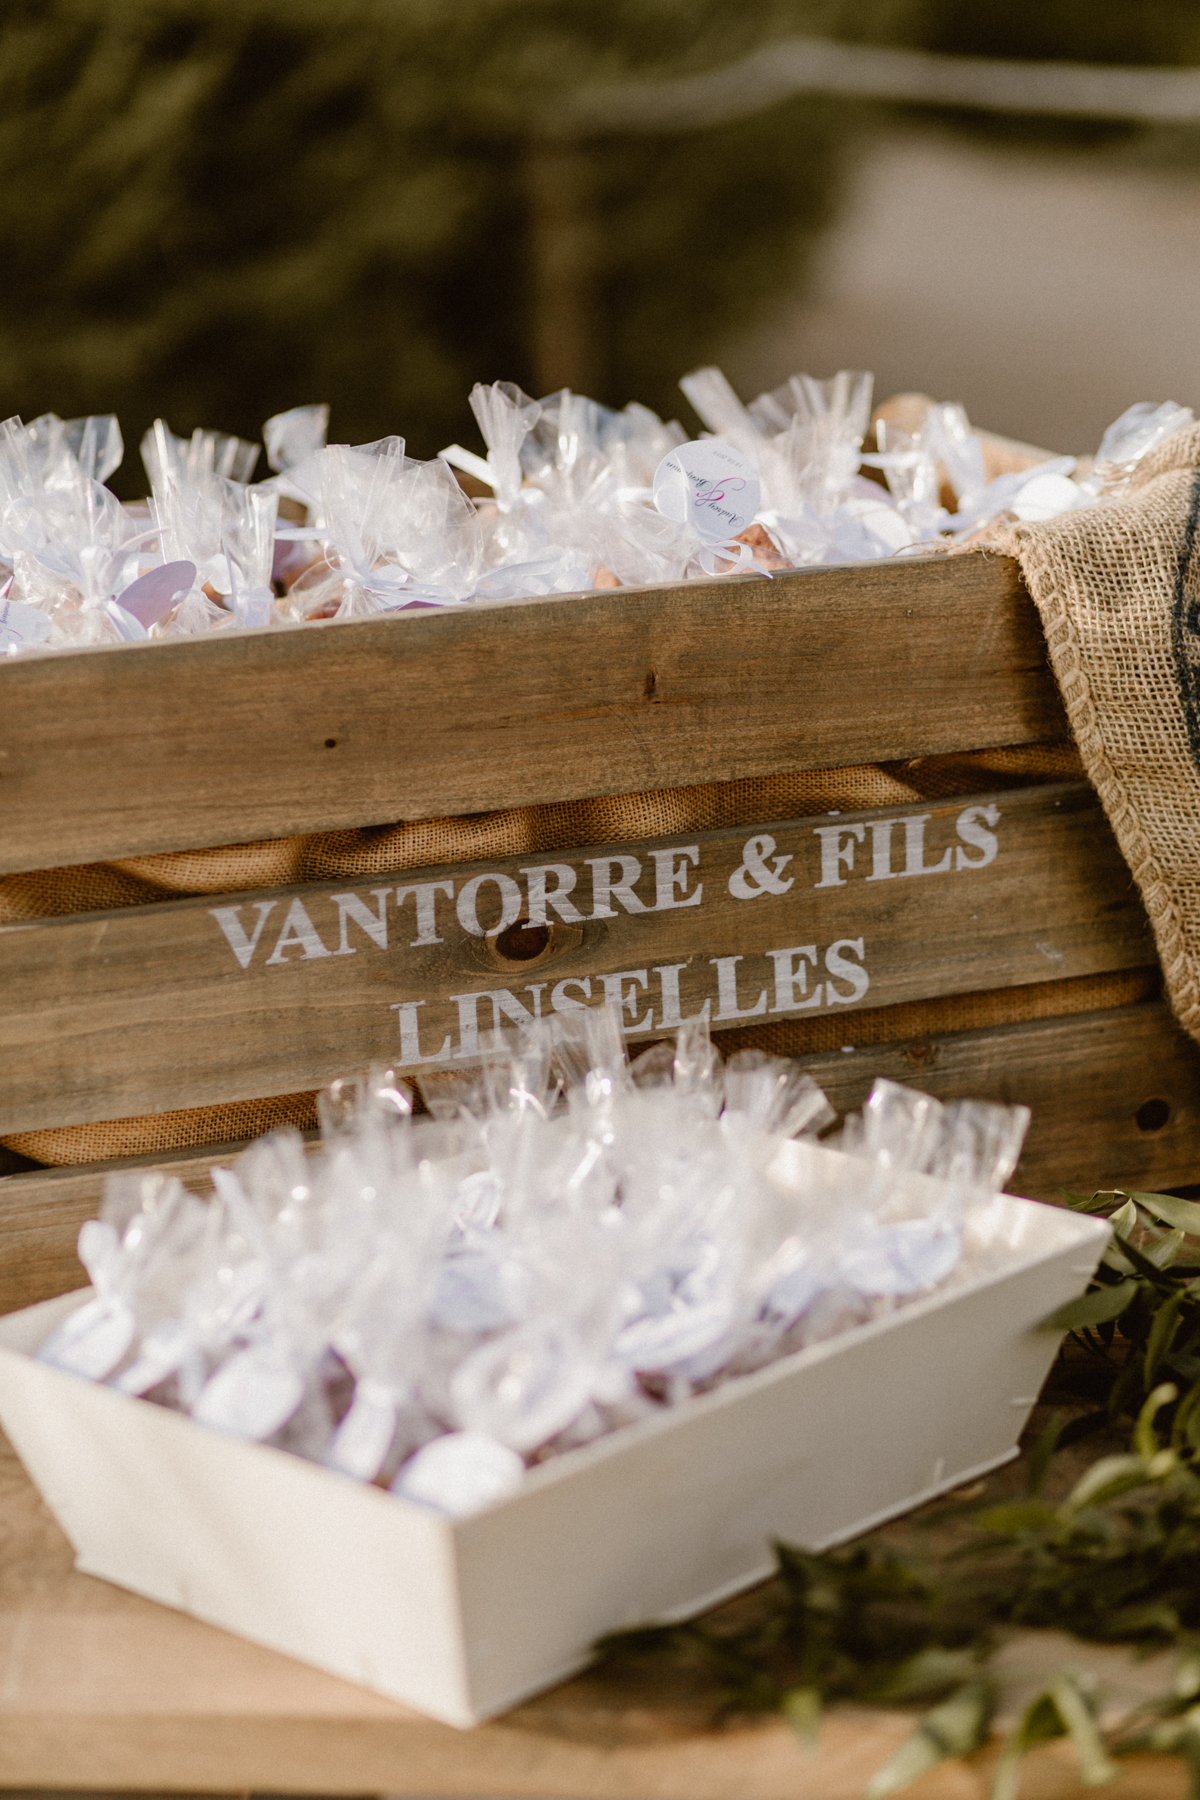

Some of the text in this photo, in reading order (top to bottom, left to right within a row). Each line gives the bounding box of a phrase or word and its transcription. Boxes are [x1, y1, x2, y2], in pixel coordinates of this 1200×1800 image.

[709, 502, 744, 527] Audrey
[208, 803, 1001, 969] VANTORRE & FILS
[389, 937, 870, 1067] LINSELLES
